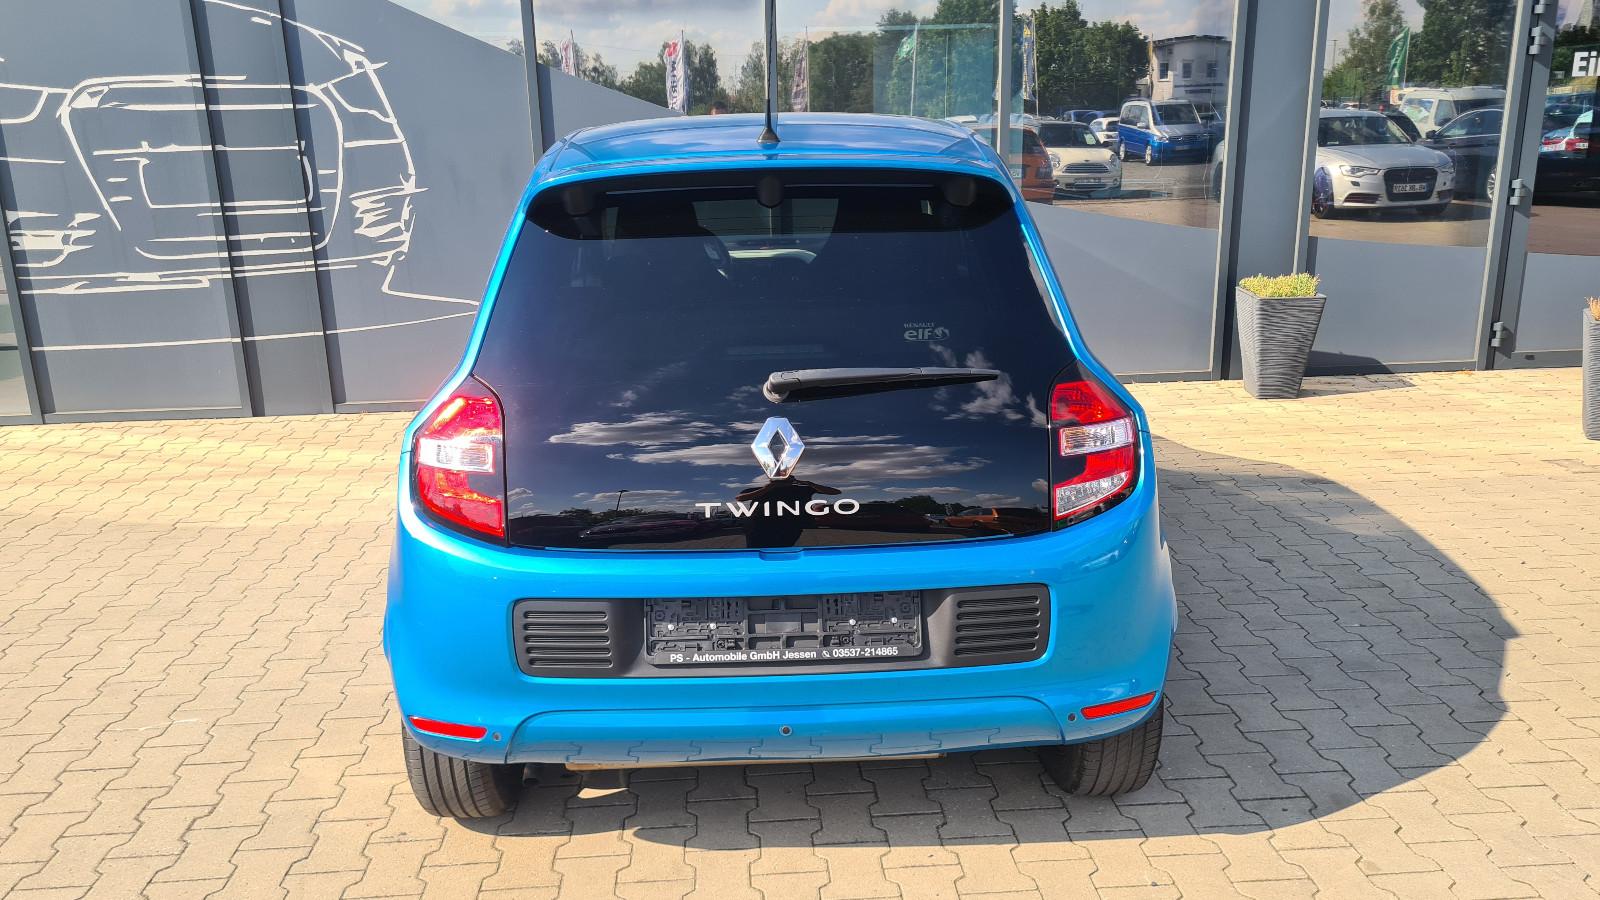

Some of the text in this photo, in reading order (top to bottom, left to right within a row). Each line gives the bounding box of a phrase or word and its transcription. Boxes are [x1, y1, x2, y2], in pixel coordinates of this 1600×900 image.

[1571, 51, 1600, 77] Ei
[695, 498, 860, 518] TWINGO
[669, 653, 684, 663] PS
[692, 651, 748, 662] Automobile
[749, 651, 780, 661] GmbH
[782, 650, 817, 660] Jessen
[832, 646, 899, 658] 03537-214865
